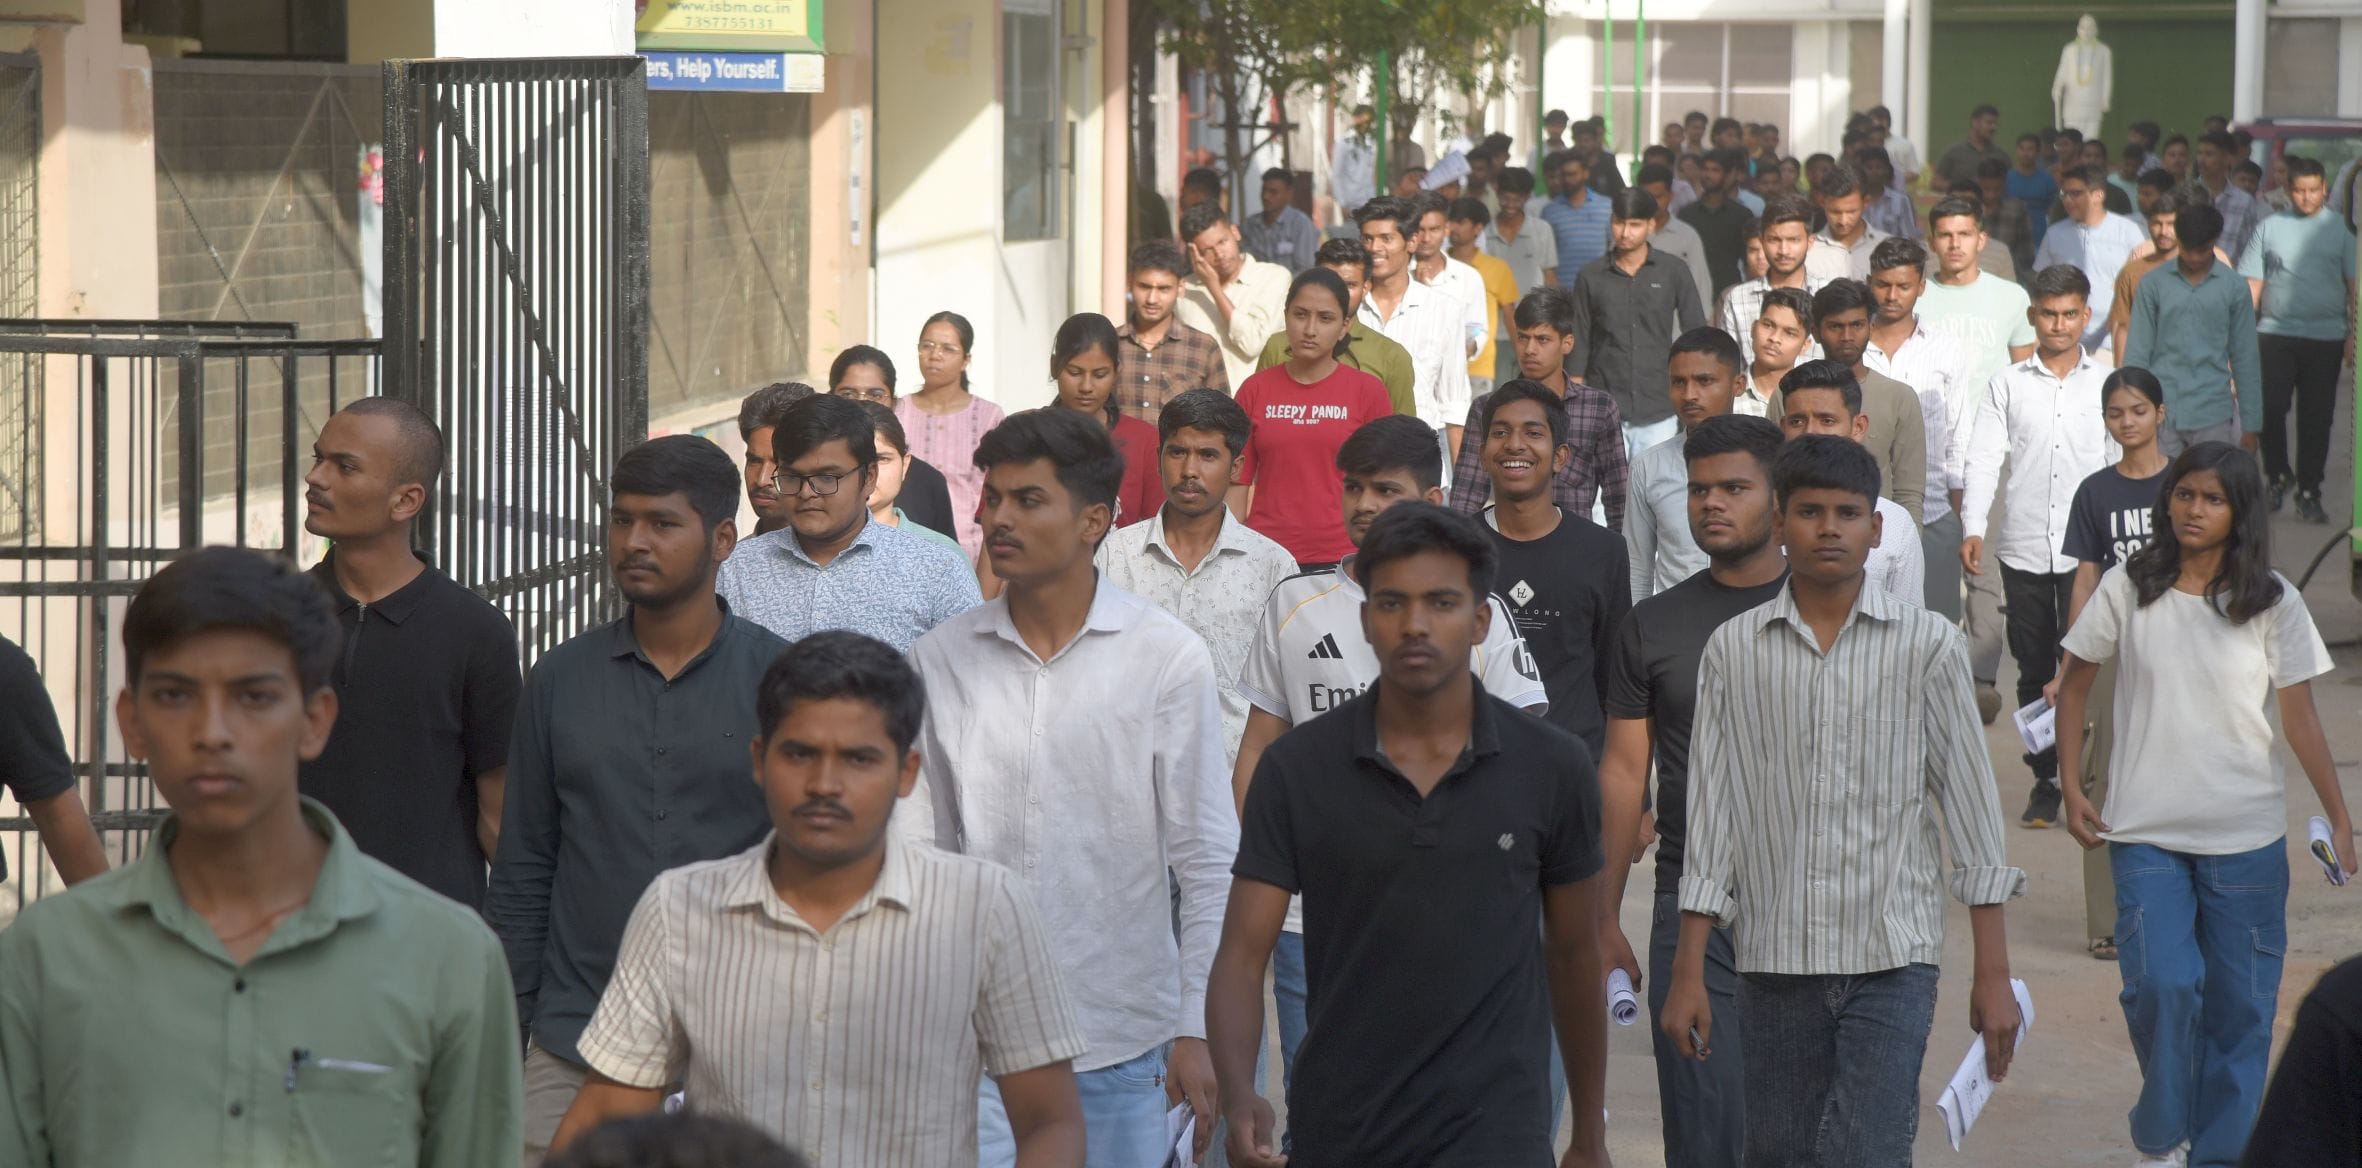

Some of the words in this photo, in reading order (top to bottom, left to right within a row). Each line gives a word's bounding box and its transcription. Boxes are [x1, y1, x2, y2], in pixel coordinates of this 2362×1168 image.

[647, 61, 674, 80] ers,
[676, 57, 711, 82] Help
[713, 58, 780, 79] Yourself.
[1265, 404, 1307, 419] SLEEPY
[1311, 405, 1348, 420] PANDA
[2110, 511, 2118, 538] I
